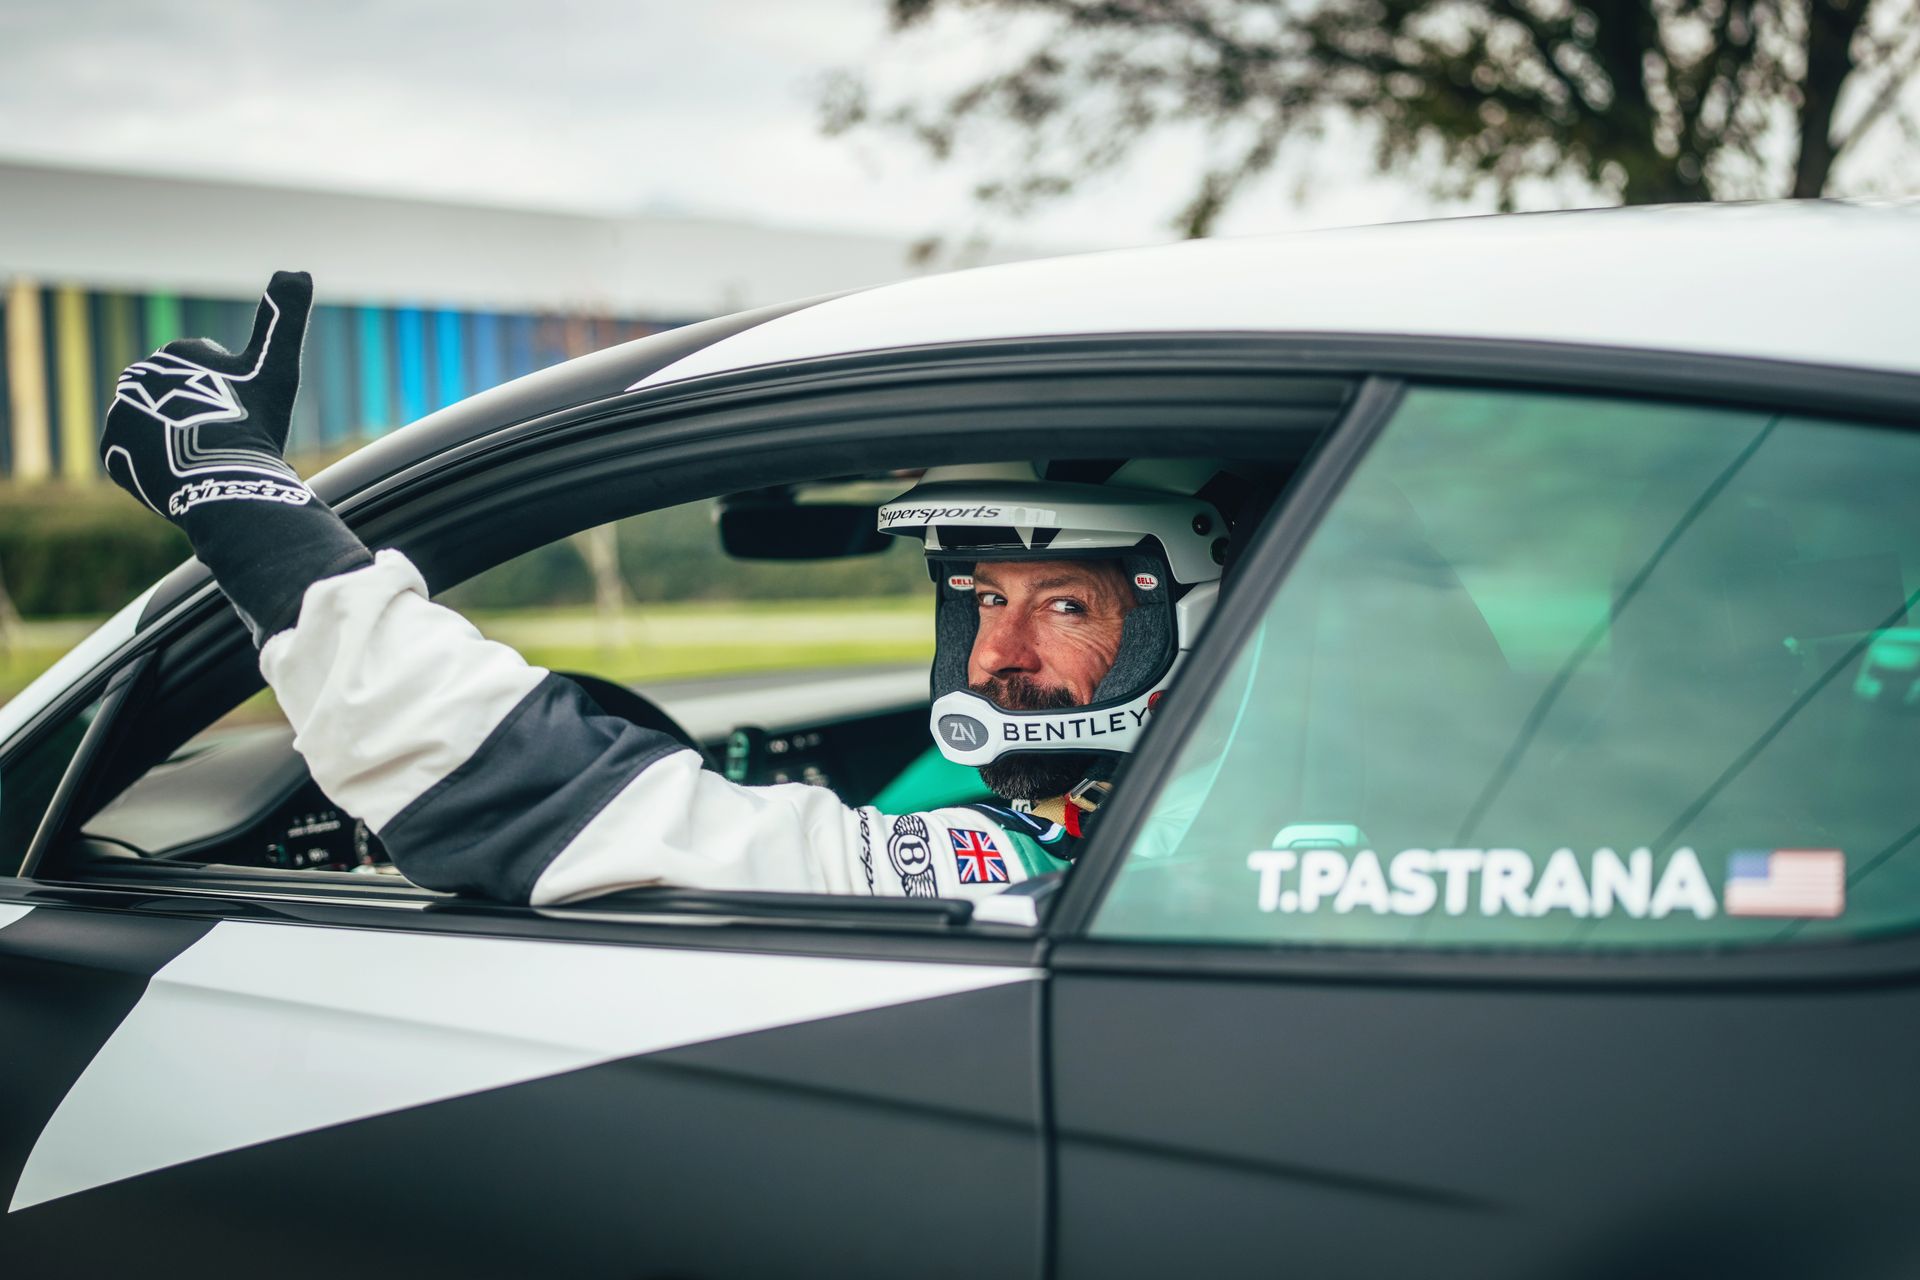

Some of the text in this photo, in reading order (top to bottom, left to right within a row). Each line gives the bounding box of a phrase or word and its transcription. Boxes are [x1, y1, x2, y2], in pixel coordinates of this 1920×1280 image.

[879, 505, 1001, 526] Supersports
[1136, 576, 1155, 585] BELL
[1002, 706, 1148, 742] BENTLEY
[1246, 848, 1717, 919] T.PASTRANA
